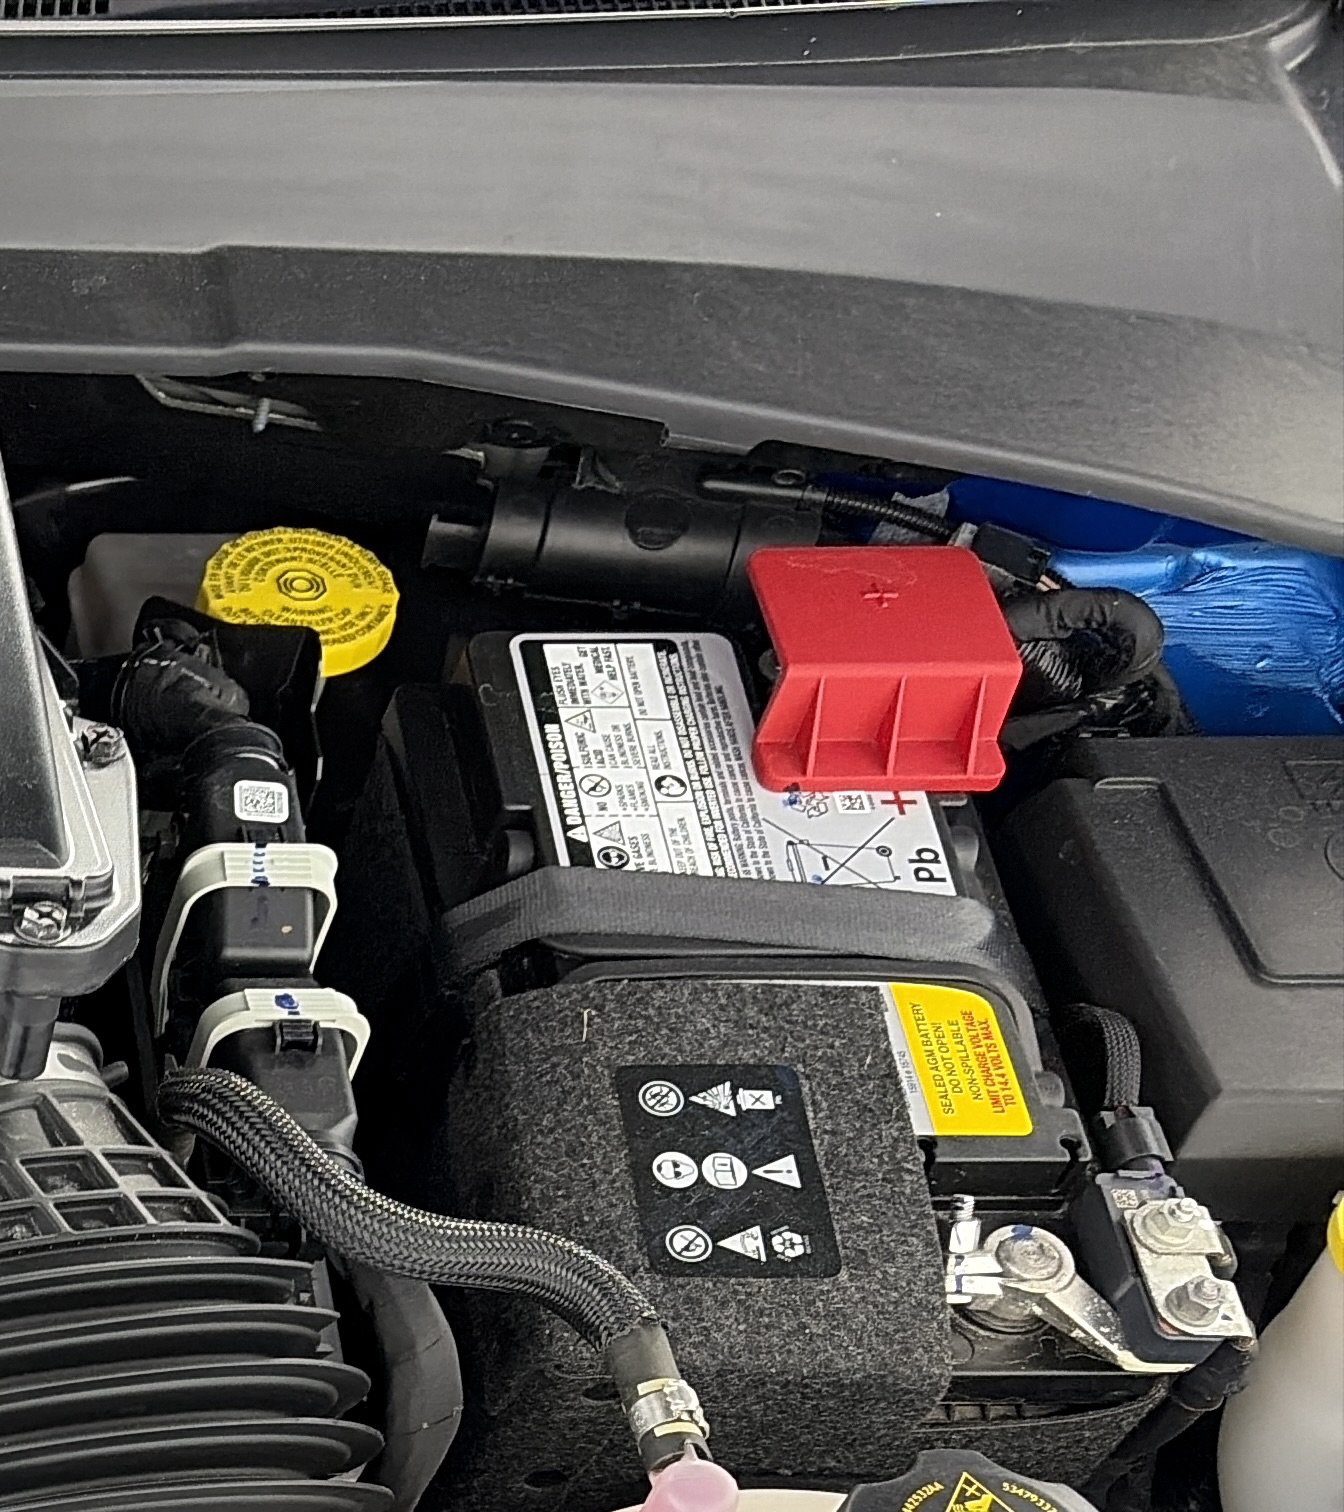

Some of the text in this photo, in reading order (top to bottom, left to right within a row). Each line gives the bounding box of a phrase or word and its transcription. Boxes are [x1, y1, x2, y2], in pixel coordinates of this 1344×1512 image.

[550, 666, 563, 683] EYES
[545, 724, 581, 824] DANGER/POISON
[907, 846, 948, 883] Pb
[909, 1002, 955, 1114] SEALED AGM BATTERY
[930, 1022, 964, 1094] DO NOT OPEN!
[947, 1020, 982, 1100] NON-SPILLABLE
[960, 1010, 1005, 1114] LIMIT CHARGE VOLTAGE
[985, 1042, 1004, 1071] VOLTS
[995, 1073, 1012, 1092] 14.4
[1002, 1094, 1016, 1106] TO
